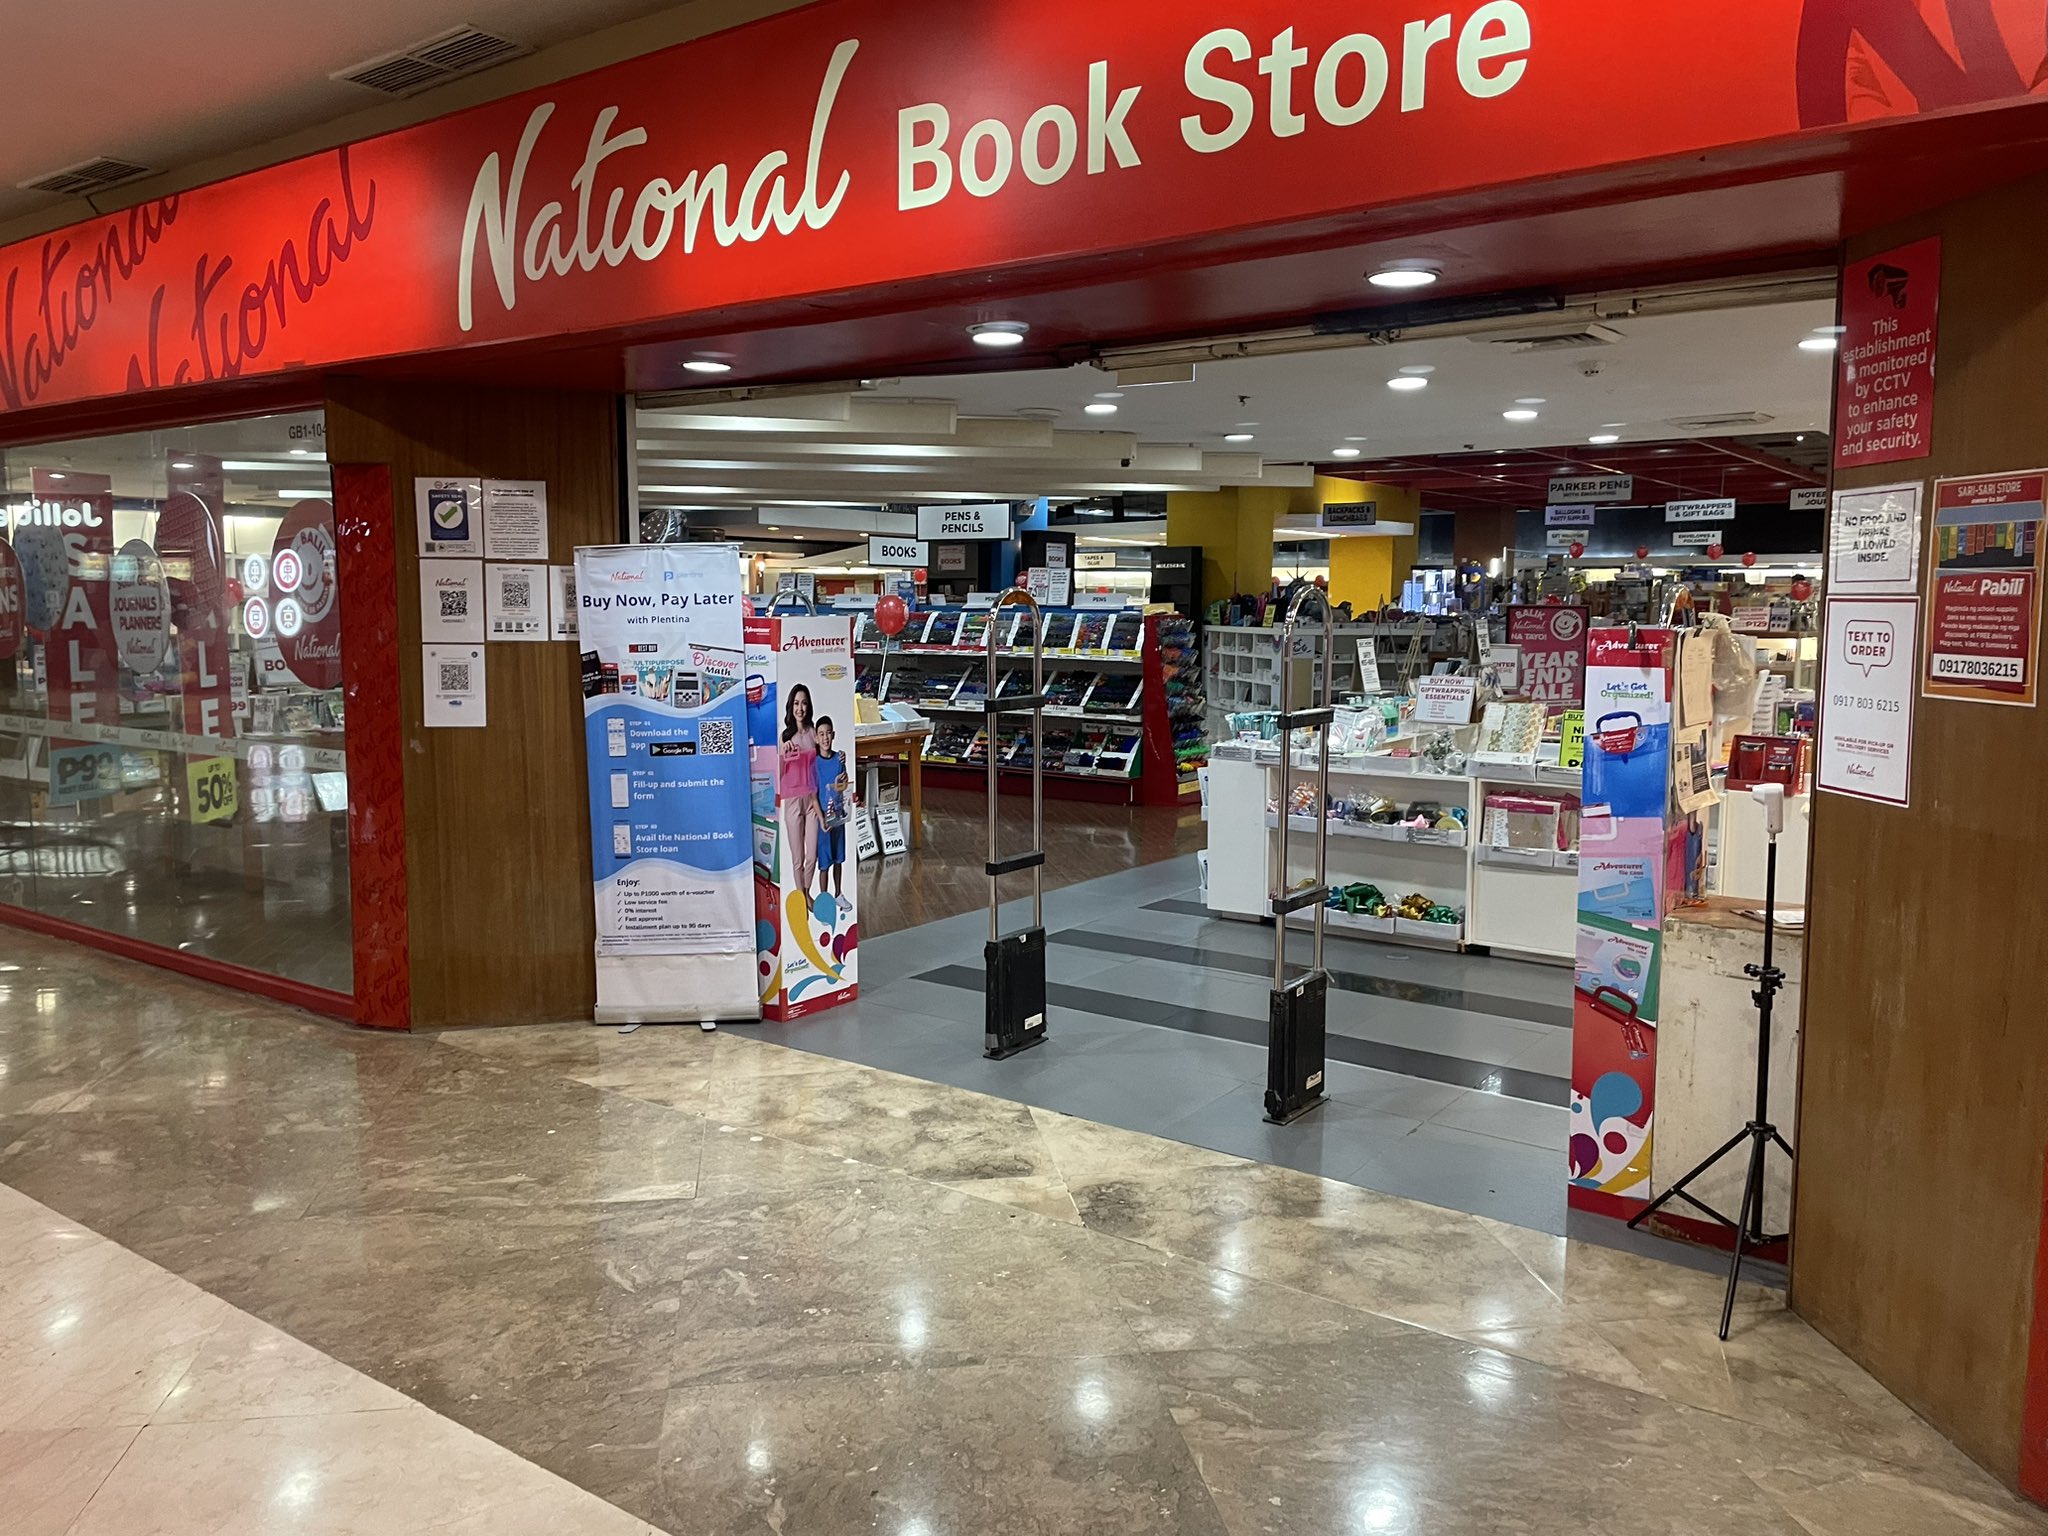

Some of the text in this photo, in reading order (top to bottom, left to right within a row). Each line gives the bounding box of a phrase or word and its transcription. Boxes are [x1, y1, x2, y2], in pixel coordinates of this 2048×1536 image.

[458, 0, 1531, 332] National Book Store
[1873, 317, 1898, 336] This
[1843, 328, 1932, 364] establishment
[1859, 347, 1927, 378] monitored
[1856, 383, 1870, 398] by
[1874, 372, 1912, 393] CCTV
[1849, 393, 1918, 417] to enhance
[1847, 412, 1918, 439] your safety
[1842, 432, 1921, 456] and security.
[1551, 480, 1630, 492] PARKER PENS
[1958, 481, 2022, 497] SARI-SARI STORE
[1668, 502, 1733, 512] GIFTWRAPPERS
[945, 512, 980, 521] PENS &
[1845, 517, 1857, 526] NO
[942, 524, 984, 533] PENCILS
[882, 546, 916, 557] BOOKS
[435, 578, 468, 587] National
[1944, 578, 2024, 596] National Pabili
[114, 597, 156, 611] JOURNALS
[582, 593, 734, 610] Buy Now, Pay Later
[627, 616, 690, 624] with Plentina
[1515, 609, 1544, 619] BALIK
[783, 636, 845, 651] Adventurer
[1848, 631, 1890, 643] TEXT TO
[294, 633, 341, 661] National
[1851, 645, 1885, 656] ORDER
[693, 652, 739, 669] Discover
[1521, 651, 1579, 669] YEAR
[705, 666, 731, 676] Math
[1940, 659, 2018, 677] 09178036215
[1524, 668, 1572, 684] END
[1421, 687, 1470, 695] GIFTWRAPPING
[1520, 682, 1573, 700] SALE
[1833, 695, 1899, 712] 0917 803 6215
[630, 729, 672, 737] Download
[1847, 763, 1875, 777] National
[633, 781, 658, 789] Fill-up
[660, 780, 675, 788] and
[674, 833, 710, 841] National
[713, 831, 734, 839] Book
[859, 841, 874, 853] P100
[886, 839, 903, 848] P100
[1593, 862, 1643, 871] Adventurer
[617, 879, 640, 887] Enjoy:
[1608, 937, 1648, 950] Adventurer
